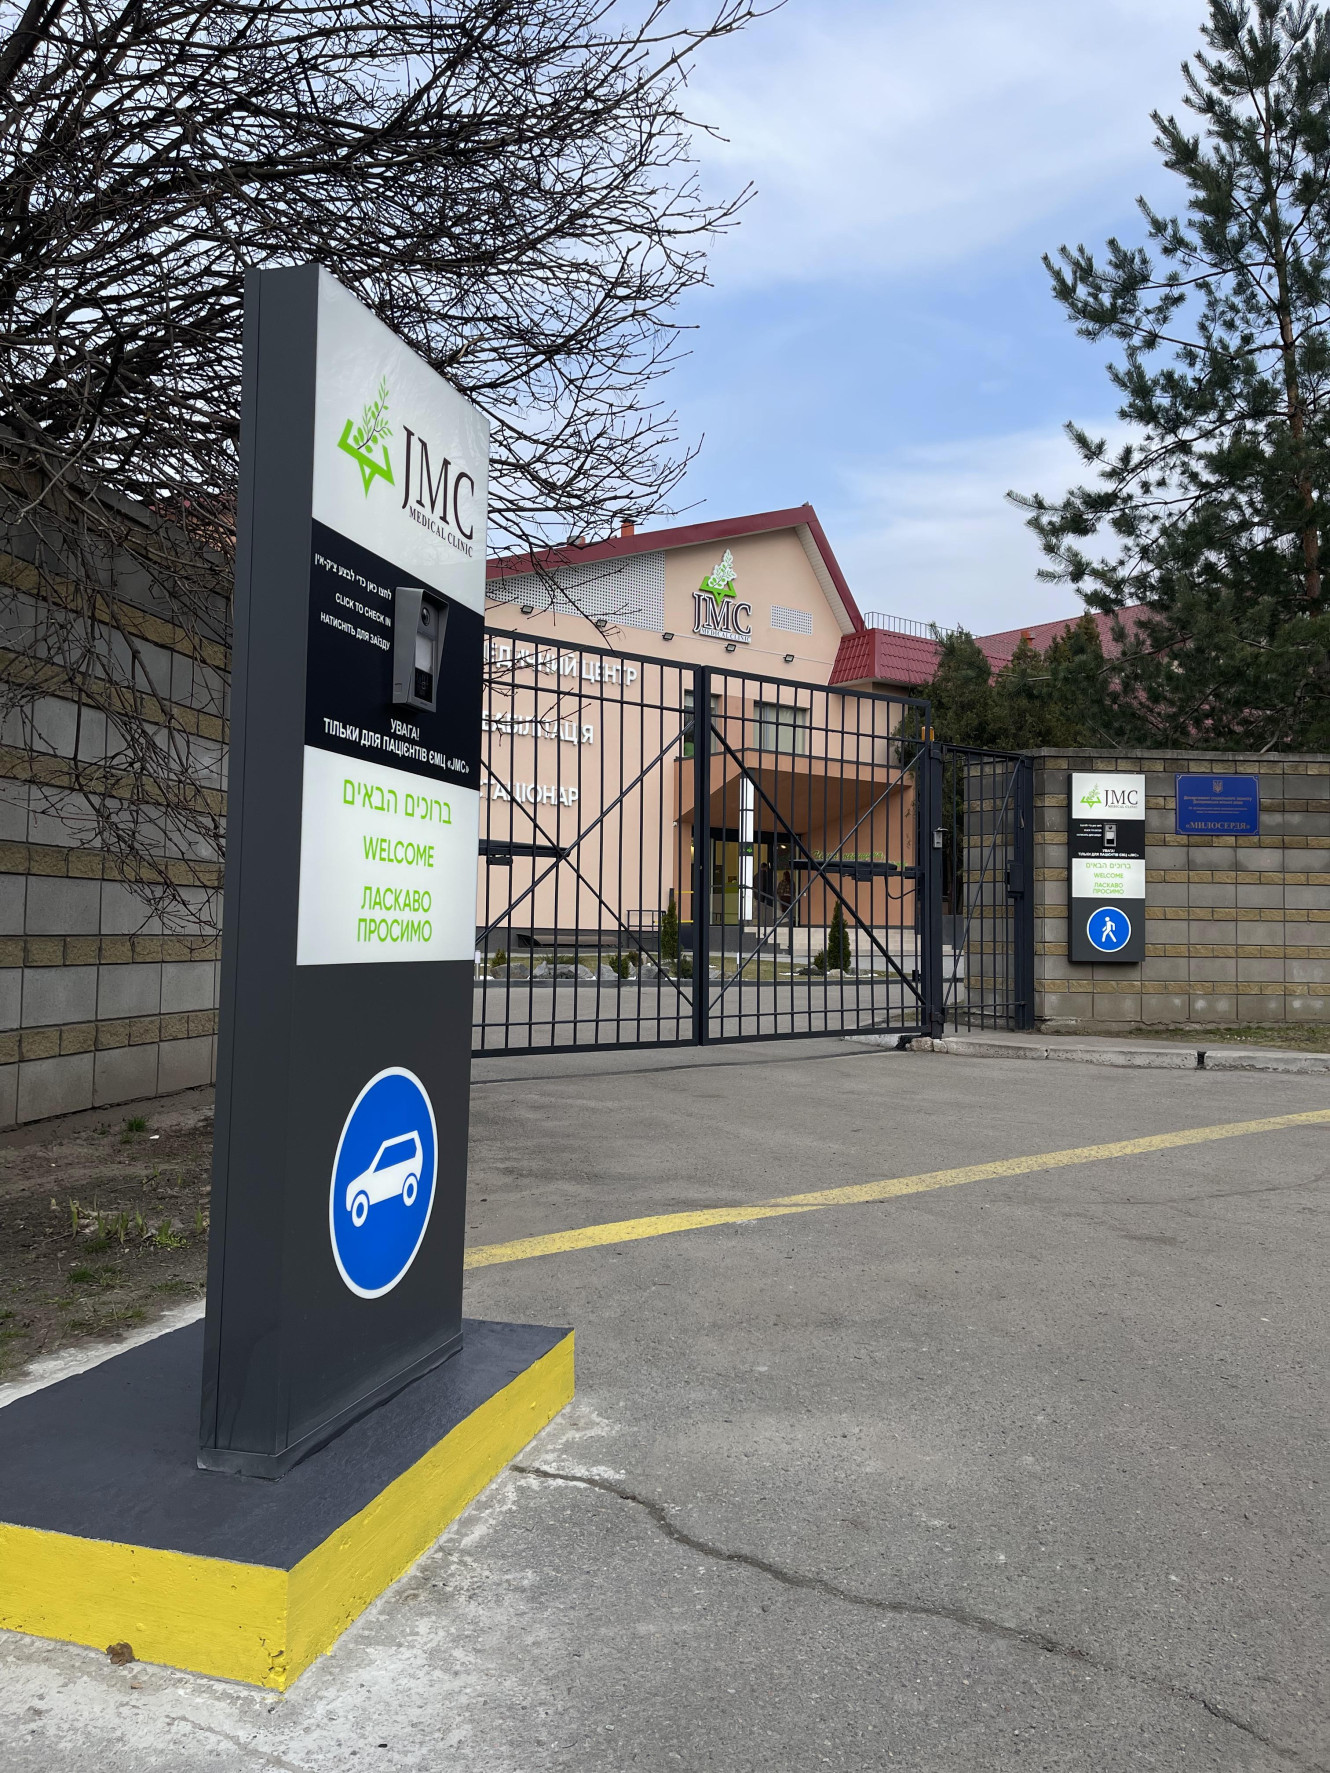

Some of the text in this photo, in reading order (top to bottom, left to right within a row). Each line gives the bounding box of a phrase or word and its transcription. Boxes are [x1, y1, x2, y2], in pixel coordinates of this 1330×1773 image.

[402, 424, 475, 540] JMC
[409, 505, 474, 558] MEDICAL CLINIC
[356, 575, 366, 587] כדי
[335, 592, 391, 628] CLICK TO CHECK IN
[693, 591, 753, 636] JMC
[320, 611, 391, 651] НАТИСНІТЬ ДЛЯ ЗАЇЗДУ
[582, 659, 638, 686] ЦЕНТР
[323, 717, 360, 742] ТІЛЬКИ
[360, 729, 381, 748] ДЛЯ
[382, 735, 428, 762] ПАЦІЄНТІВ
[428, 750, 446, 770] ЄМЦ
[390, 718, 420, 741] УВАГА!
[343, 778, 452, 825] ברוכים הבאים
[1104, 789, 1138, 808] JMC
[363, 835, 435, 868] WELCOME
[361, 886, 432, 913] ЛАСКАВО
[357, 918, 433, 943] ПРОСИМО
